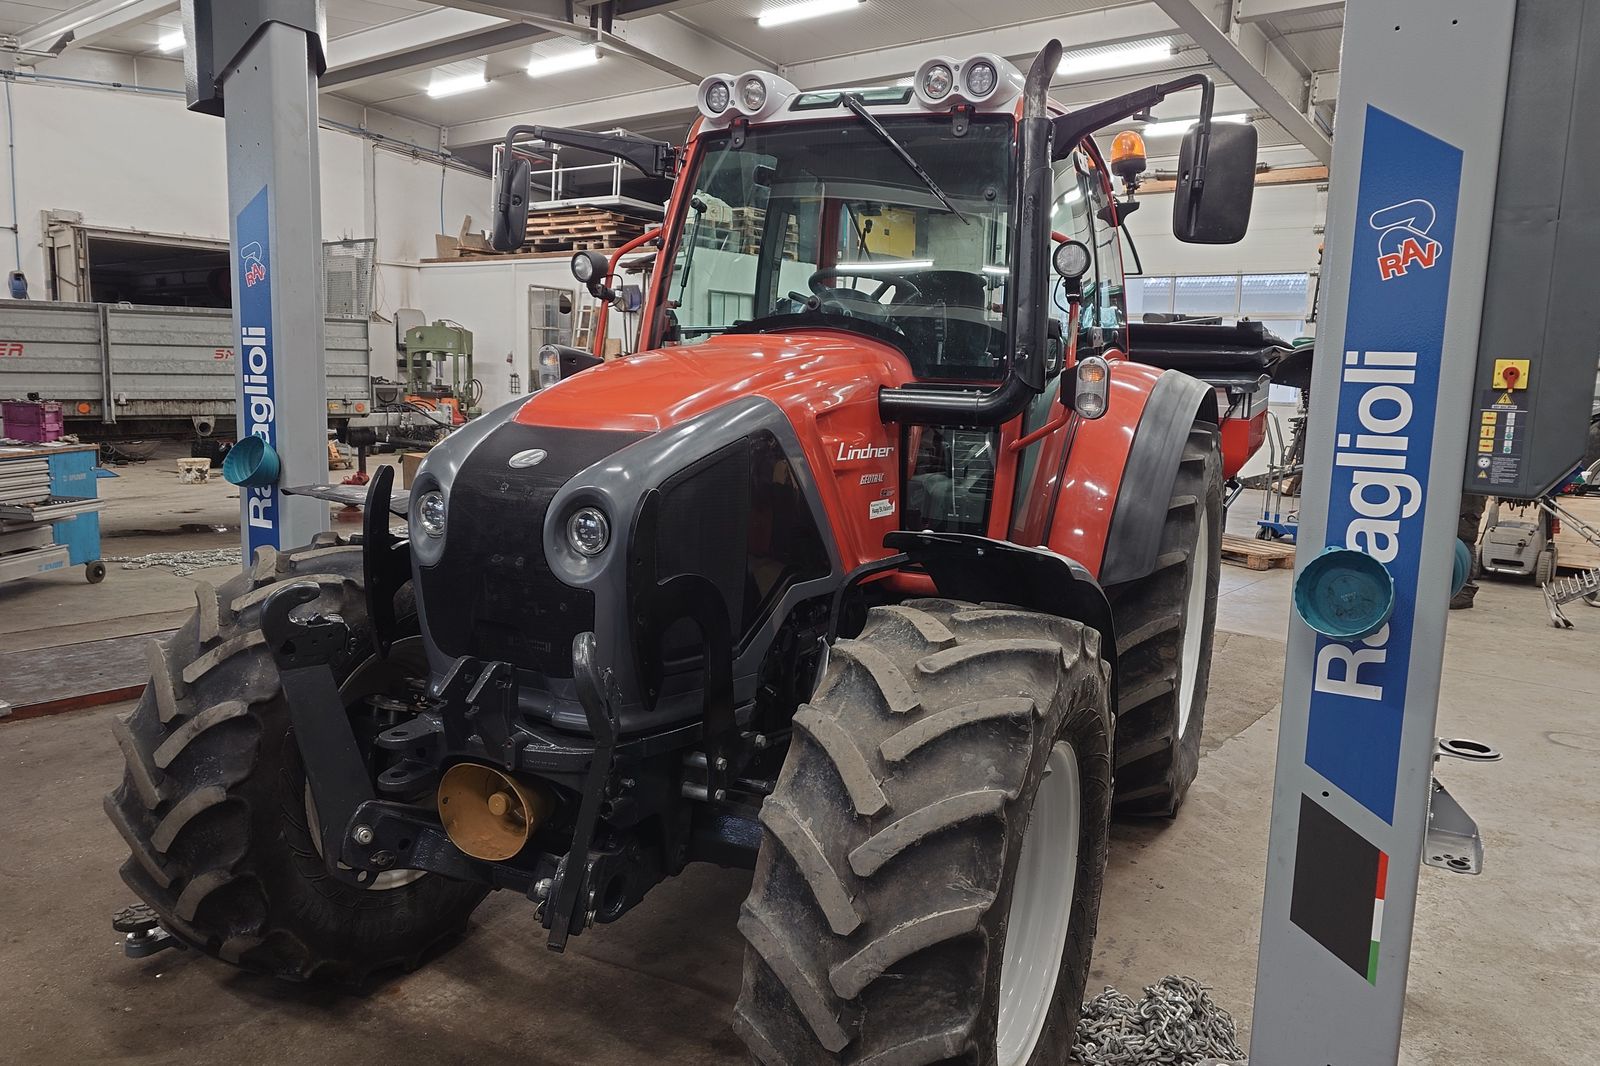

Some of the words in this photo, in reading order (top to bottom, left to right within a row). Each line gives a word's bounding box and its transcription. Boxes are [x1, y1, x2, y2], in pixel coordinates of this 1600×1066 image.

[1378, 238, 1437, 281] RAV
[246, 263, 265, 287] RAV
[837, 442, 894, 461] Lindner
